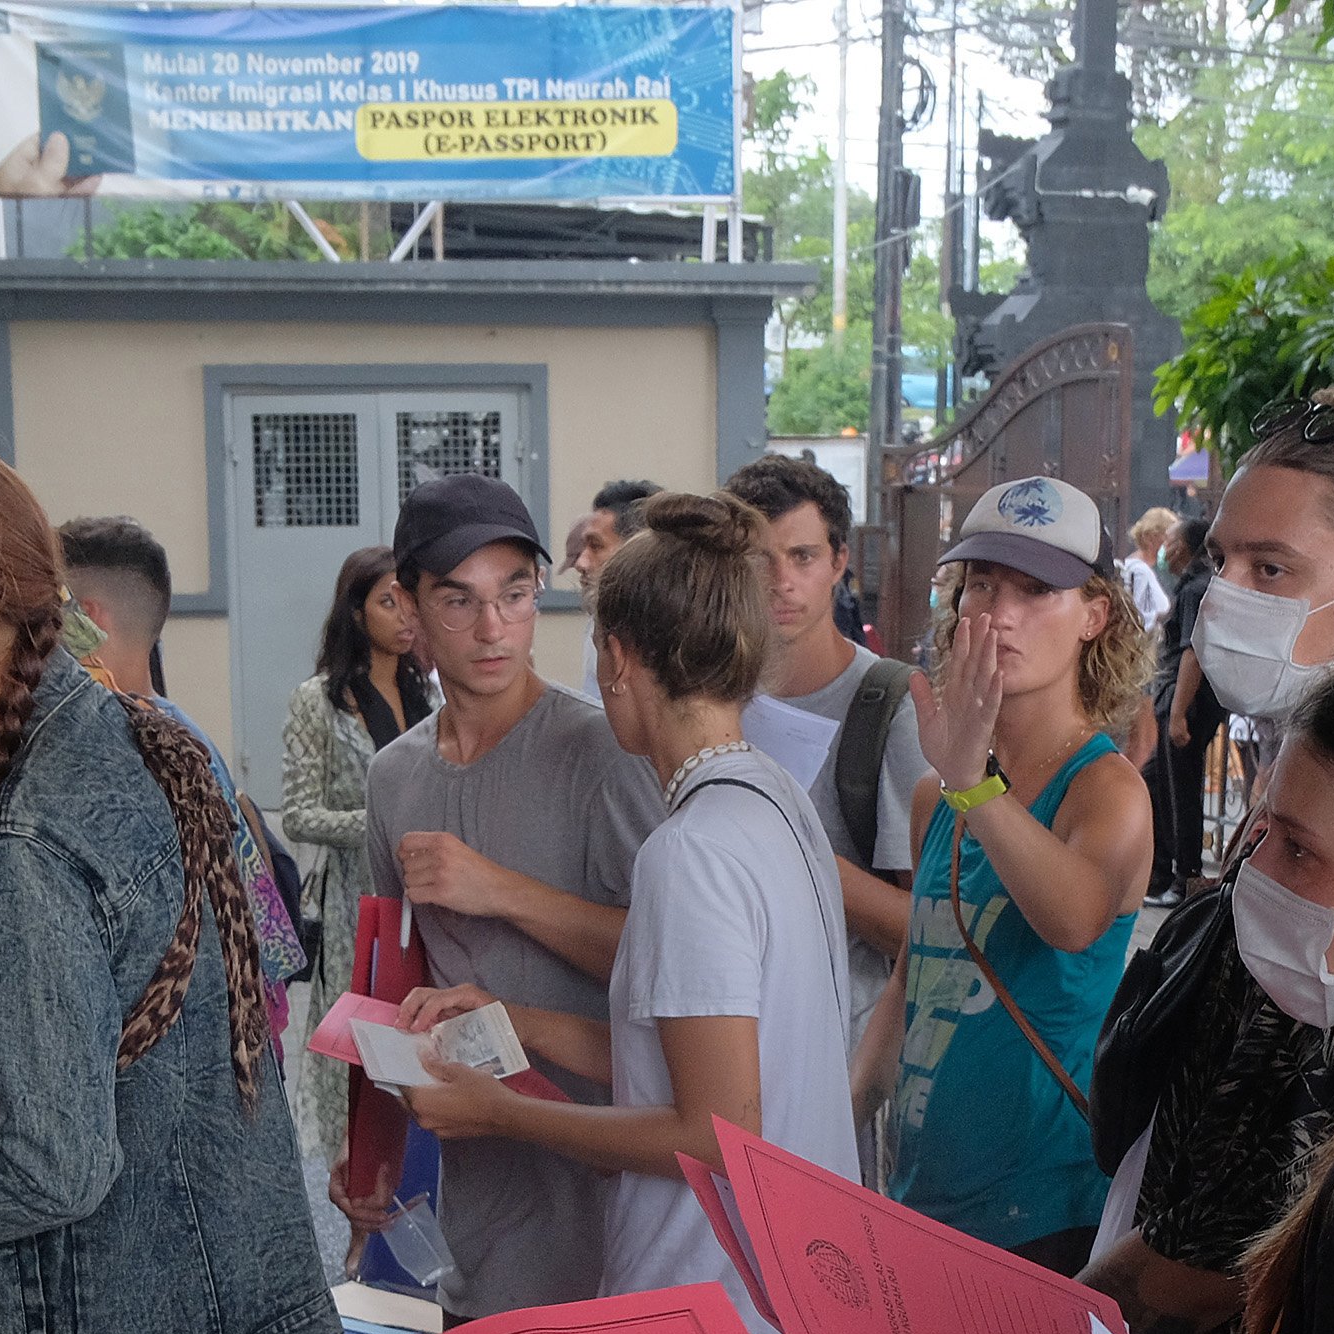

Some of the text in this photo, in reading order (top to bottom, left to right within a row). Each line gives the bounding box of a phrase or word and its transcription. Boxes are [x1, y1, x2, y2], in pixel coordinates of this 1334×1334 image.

[143, 50, 420, 76] Mulai 20 November 2019
[144, 74, 671, 107] Kantor Imigrasi Kelas I Khusus TPI Ngurah Rai
[148, 106, 659, 132] MENERBITKAN PASPOR ELEKTRONIK
[423, 130, 608, 156] (E-PASSPORT)
